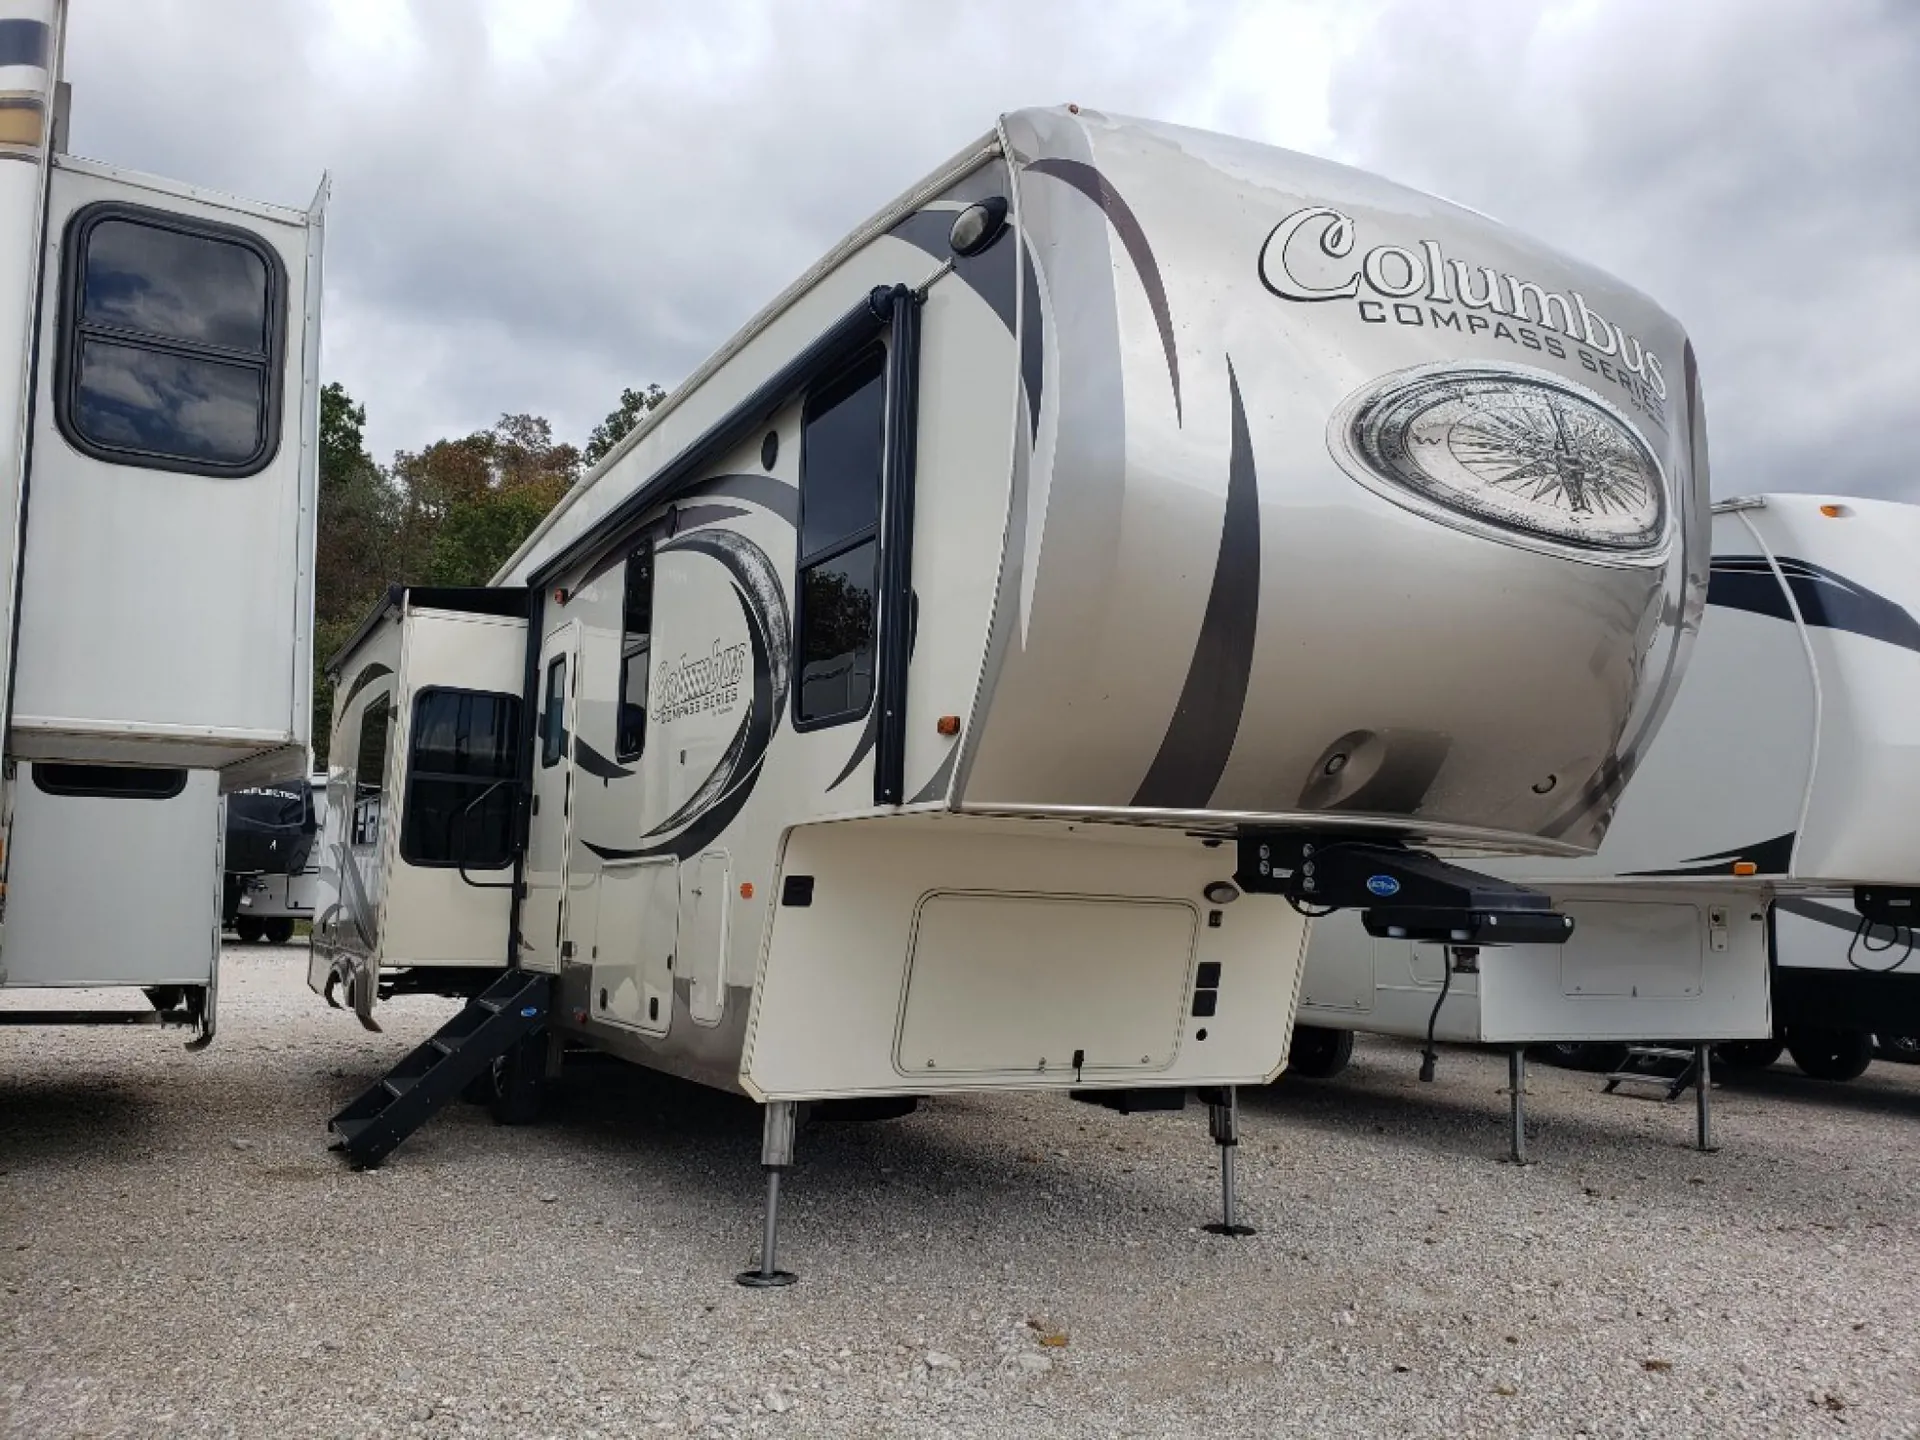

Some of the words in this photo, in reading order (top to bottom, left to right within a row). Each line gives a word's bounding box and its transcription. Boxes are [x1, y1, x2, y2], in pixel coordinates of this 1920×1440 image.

[1258, 206, 1666, 400] Columbus
[1359, 300, 1567, 360] COMPASS
[660, 699, 700, 724] COMPASS
[702, 687, 739, 712] SERIES
[234, 786, 301, 801] EFLECTION
